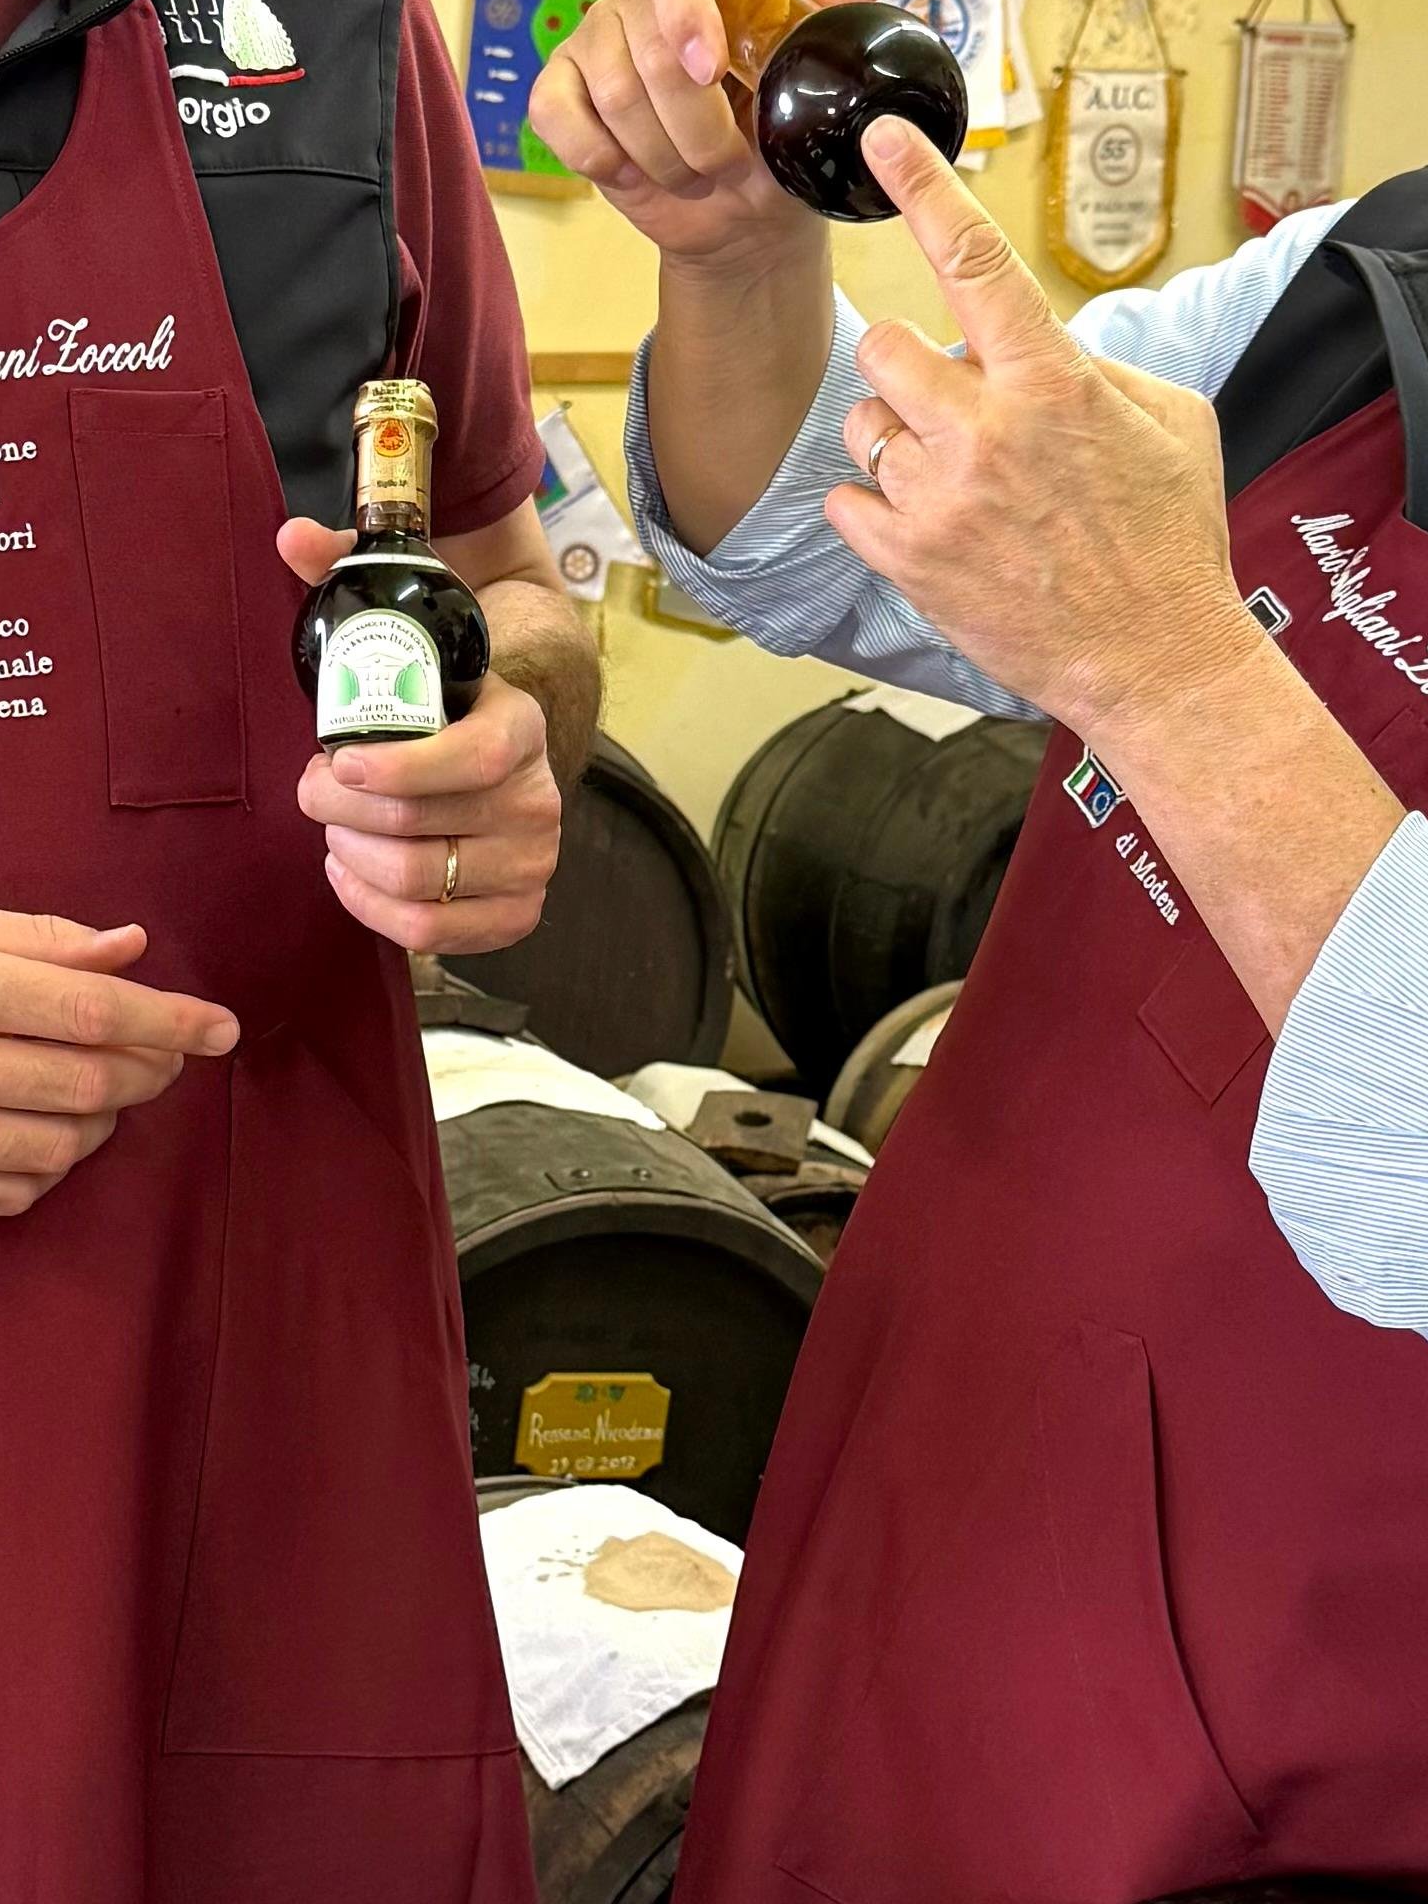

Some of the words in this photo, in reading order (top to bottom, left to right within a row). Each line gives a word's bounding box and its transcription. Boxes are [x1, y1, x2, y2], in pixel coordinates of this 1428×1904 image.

[42, 315, 175, 376] Zoccoli
[1116, 832, 1139, 859] di
[1129, 850, 1180, 926] Modena
